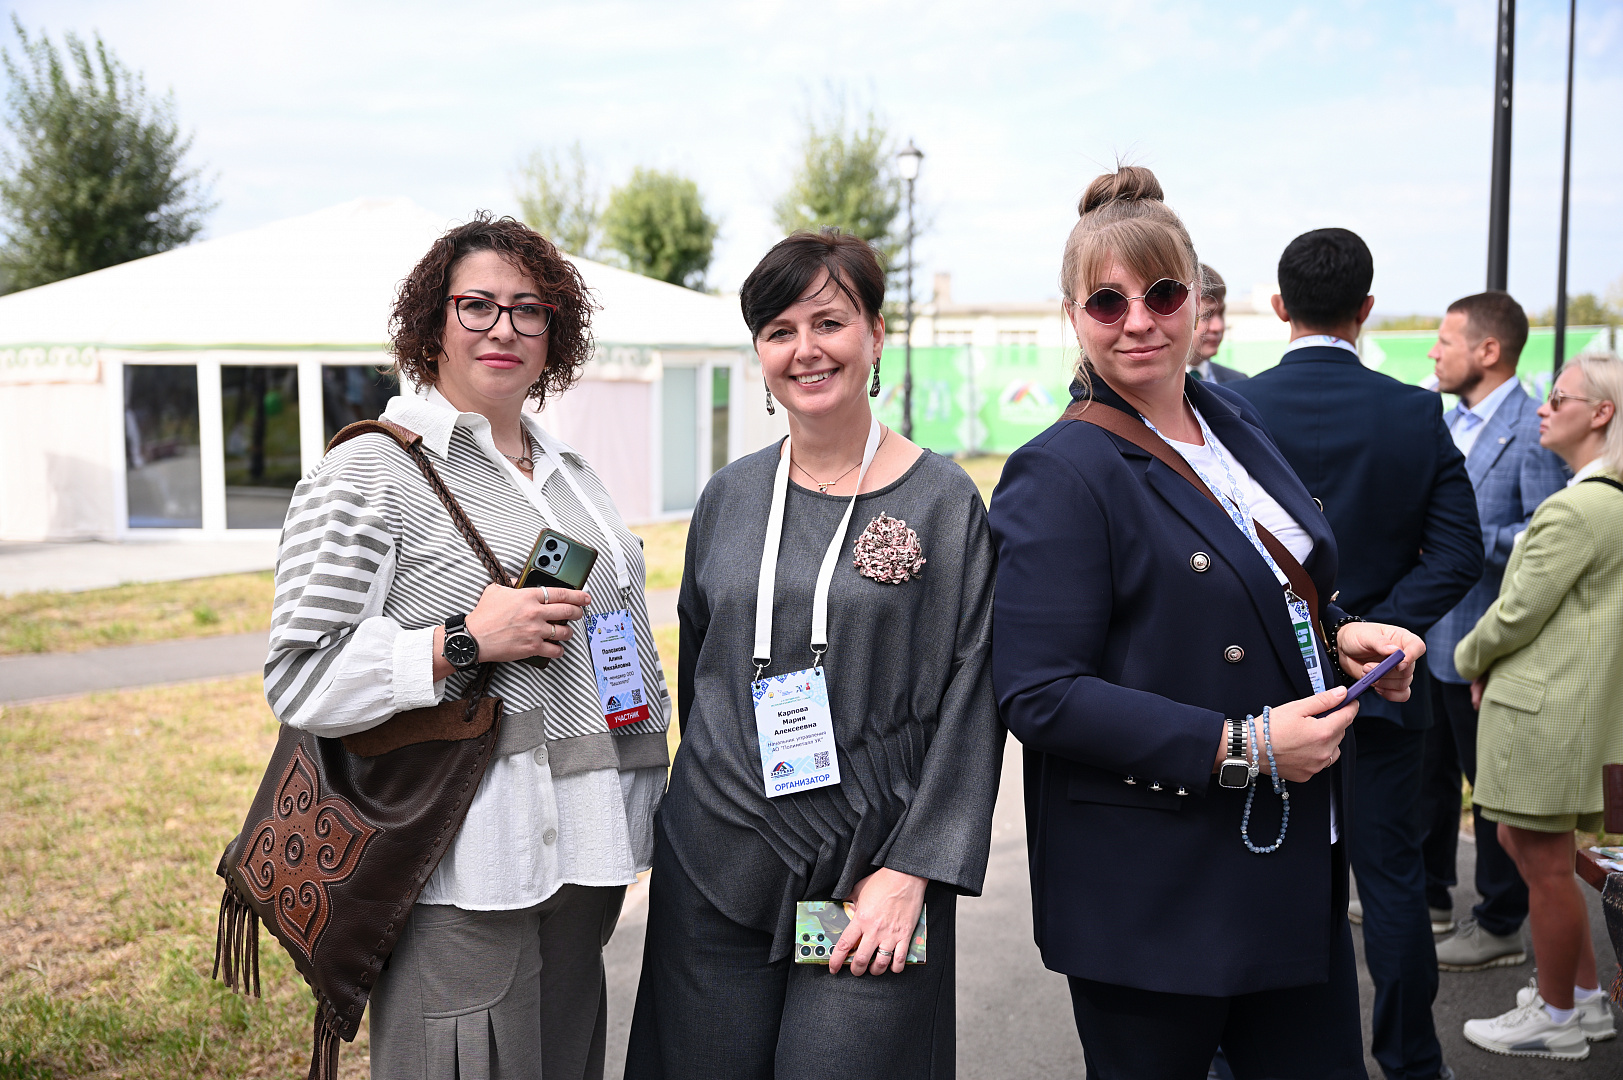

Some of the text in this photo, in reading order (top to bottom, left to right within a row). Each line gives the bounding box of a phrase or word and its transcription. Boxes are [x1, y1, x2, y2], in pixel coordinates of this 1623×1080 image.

[608, 654, 623, 663] Алина
[603, 661, 631, 672] Михайловна
[614, 711, 640, 724] УЧАСТНИК
[777, 706, 809, 718] Карпова
[782, 715, 807, 726] Мария
[774, 722, 817, 736] Алексеевна
[767, 737, 795, 747] Начальник
[774, 774, 830, 791] ОРГАНИЗАТОР
